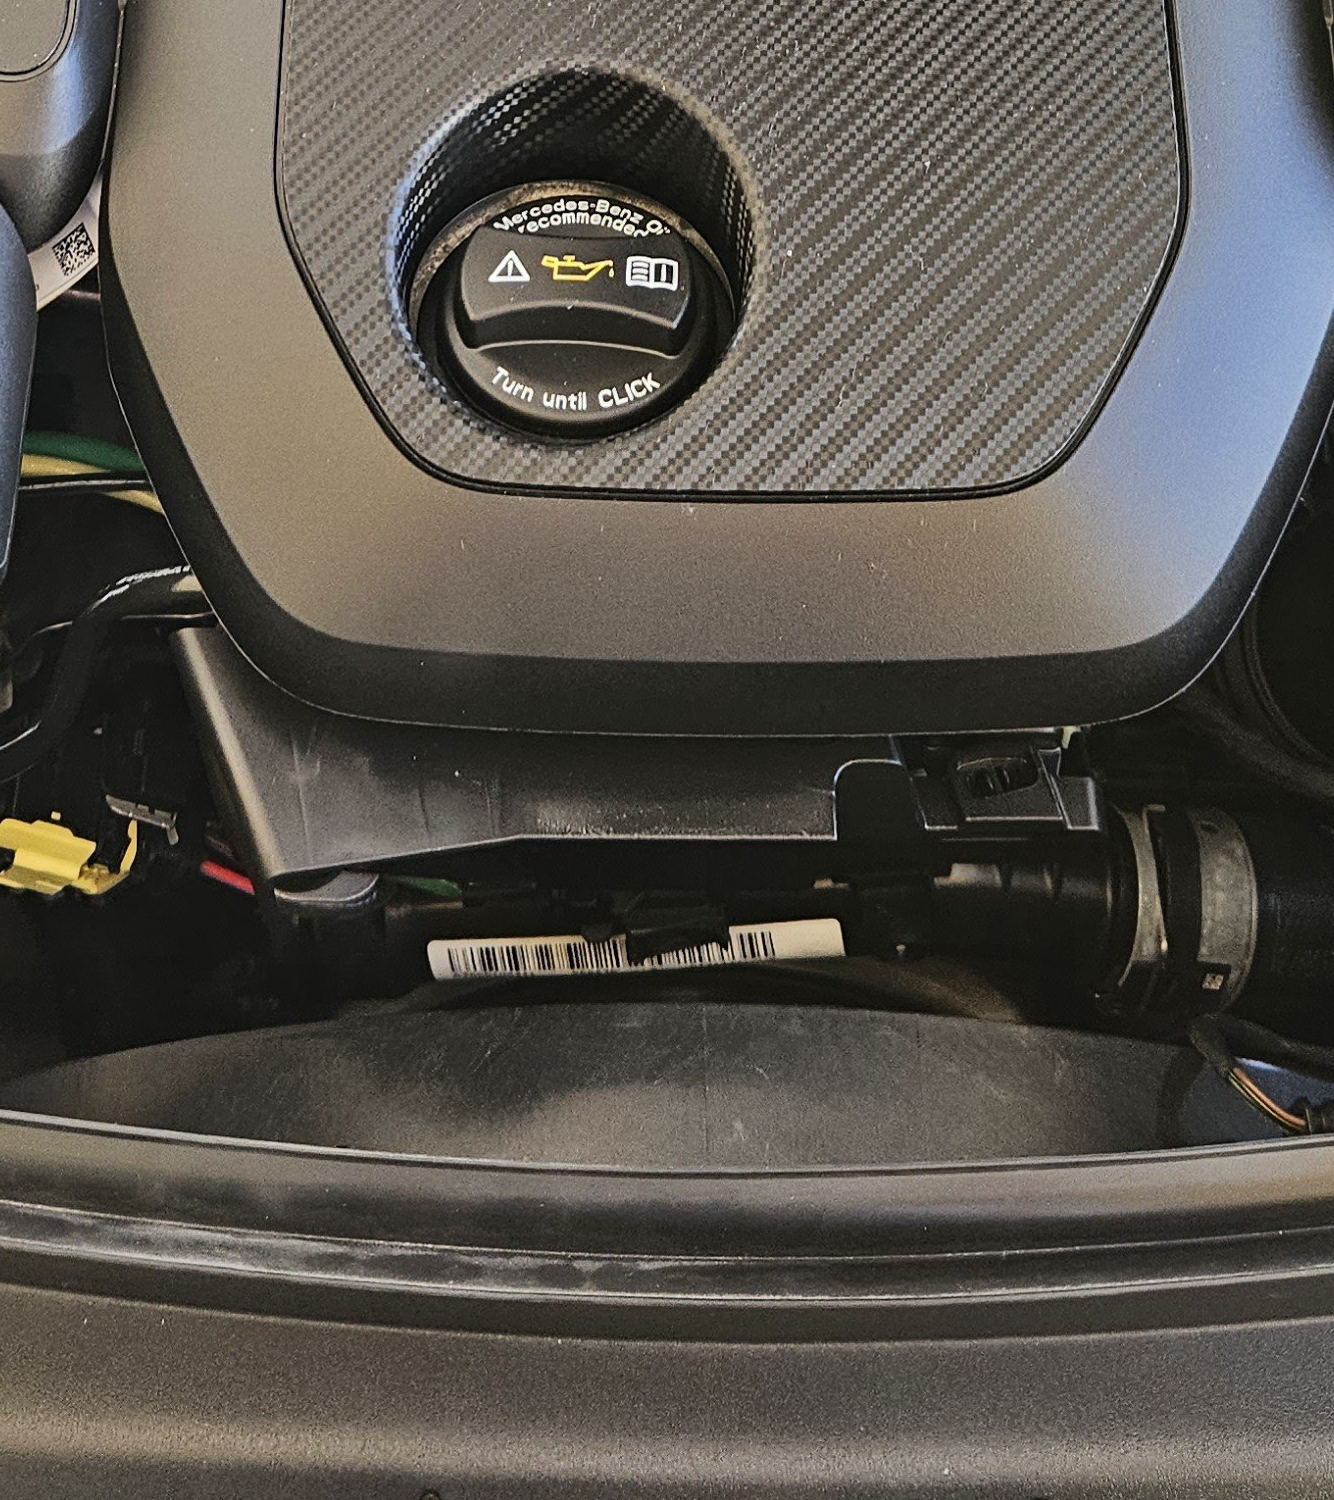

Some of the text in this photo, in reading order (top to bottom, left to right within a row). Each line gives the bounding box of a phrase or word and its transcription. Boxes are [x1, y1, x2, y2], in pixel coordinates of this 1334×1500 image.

[493, 199, 644, 231] Mercedes-Benz
[491, 366, 661, 411] Turn until CLICK
